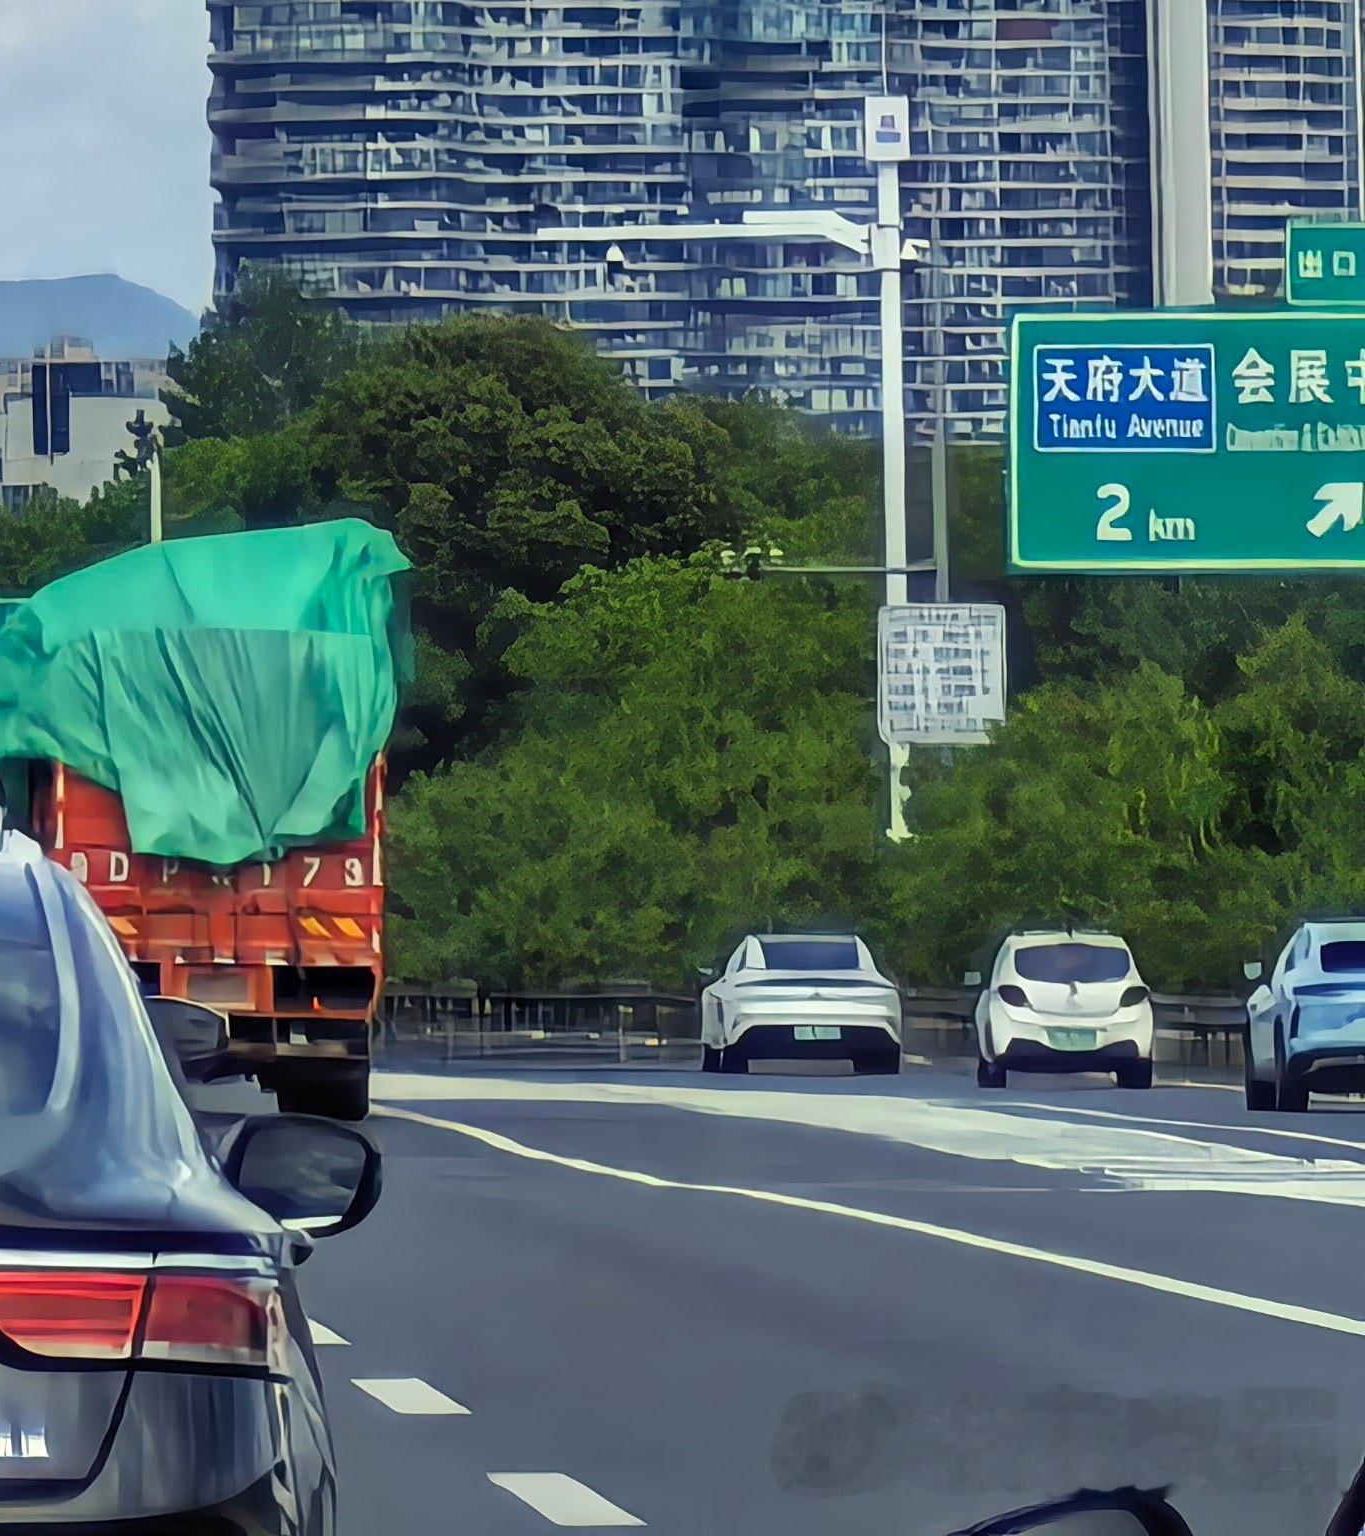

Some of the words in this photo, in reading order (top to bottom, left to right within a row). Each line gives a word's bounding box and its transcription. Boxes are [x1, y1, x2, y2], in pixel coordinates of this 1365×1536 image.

[1298, 250, 1356, 279] 出口
[1042, 355, 1208, 402] 天府大道
[1127, 414, 1204, 439] Avenue
[1097, 483, 1133, 541] 2
[1149, 508, 1195, 541] km
